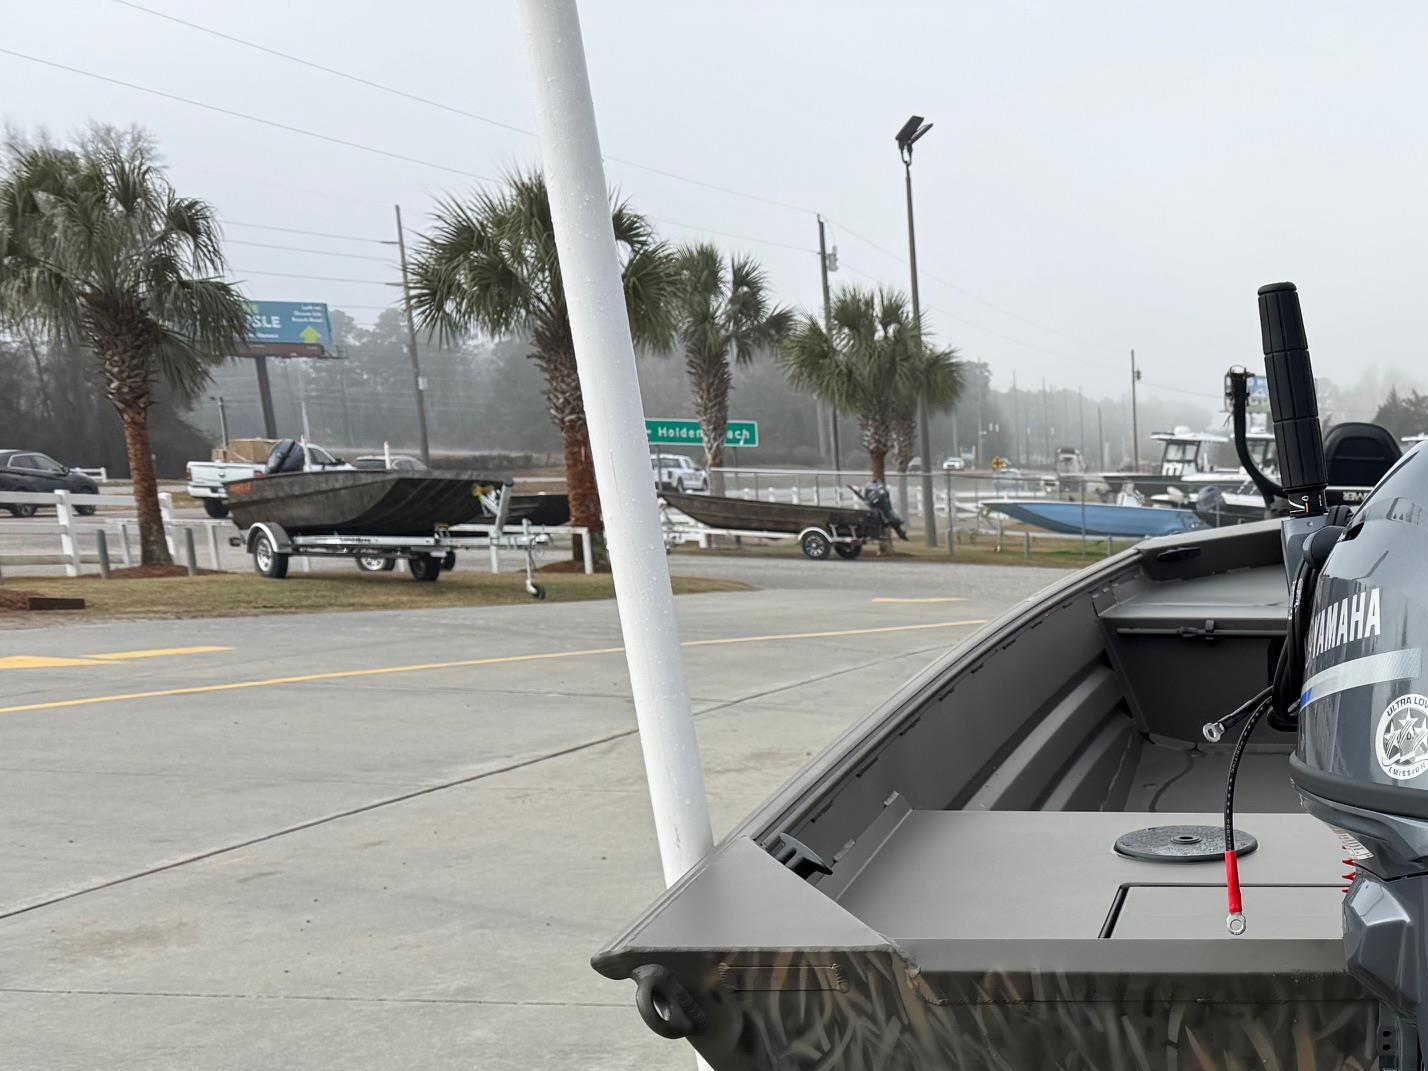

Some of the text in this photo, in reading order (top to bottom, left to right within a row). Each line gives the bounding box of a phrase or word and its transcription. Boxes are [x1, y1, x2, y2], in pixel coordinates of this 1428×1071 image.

[1312, 587, 1381, 659] YAMAHA
[1386, 696, 1412, 717] ULTRA
[1388, 762, 1426, 776] EMISSION
